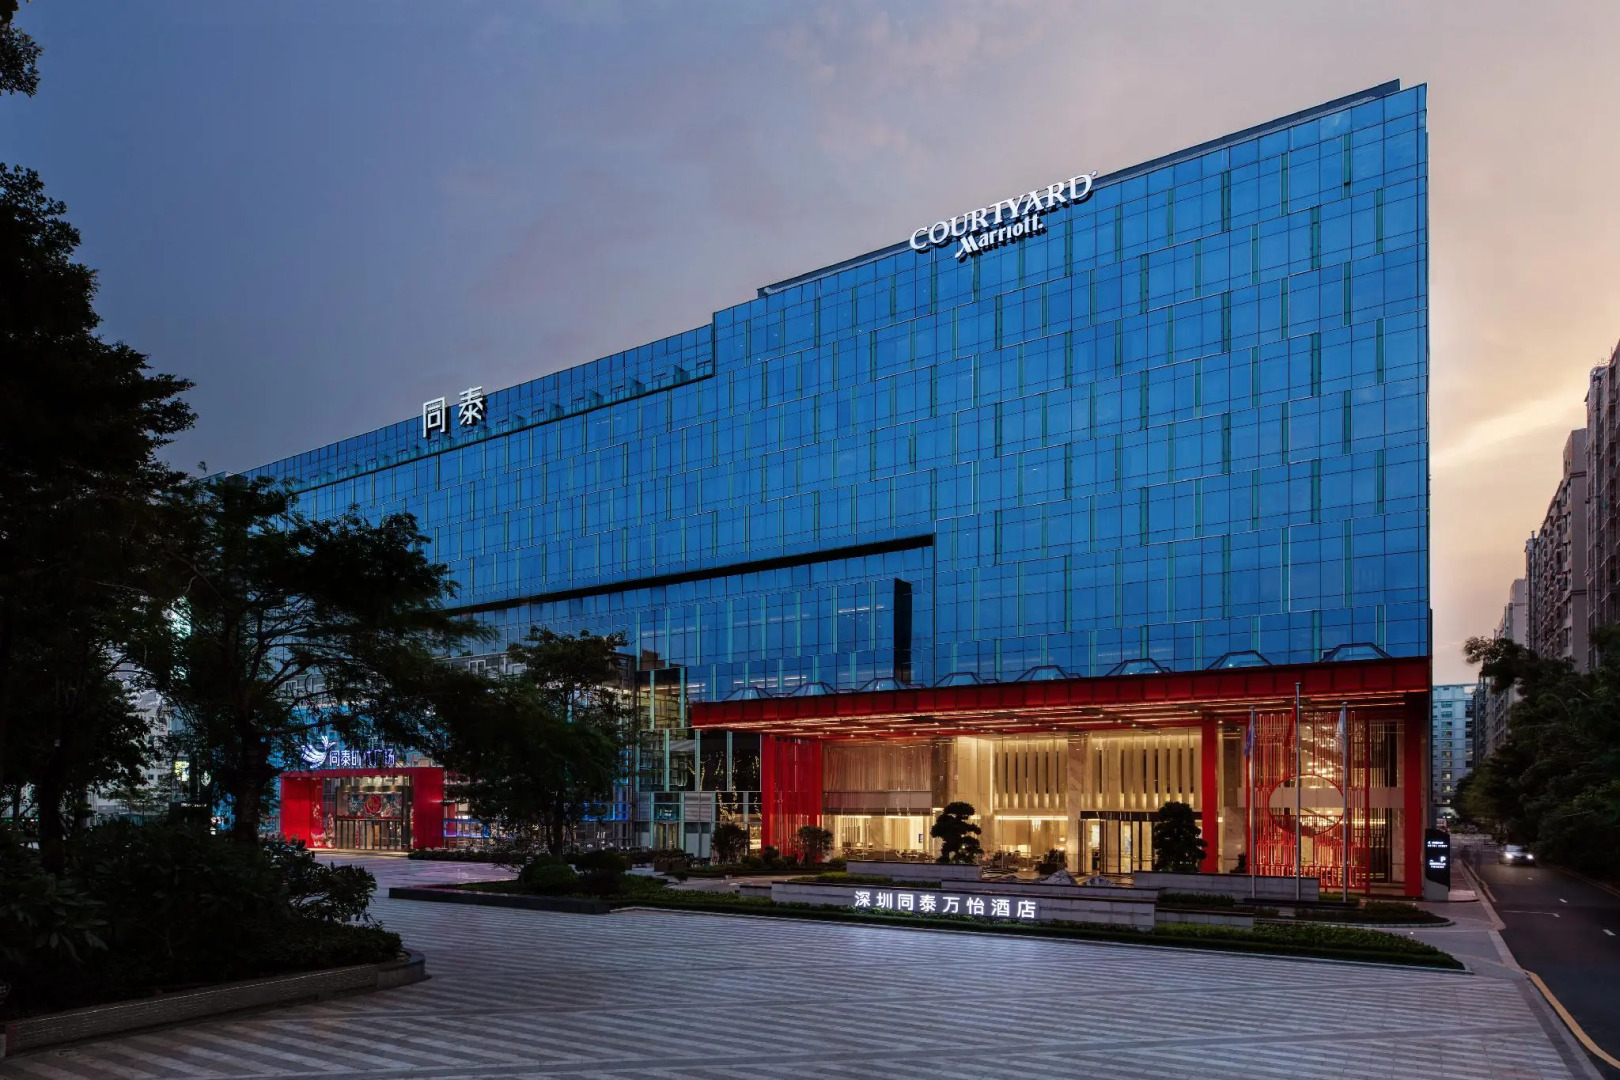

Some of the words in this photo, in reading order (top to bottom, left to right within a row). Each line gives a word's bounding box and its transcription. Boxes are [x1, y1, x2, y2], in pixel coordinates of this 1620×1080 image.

[909, 173, 1093, 250] COURTYARD
[422, 386, 484, 438] 同泰
[854, 890, 1037, 919] 深圳同泰万怡酒店
